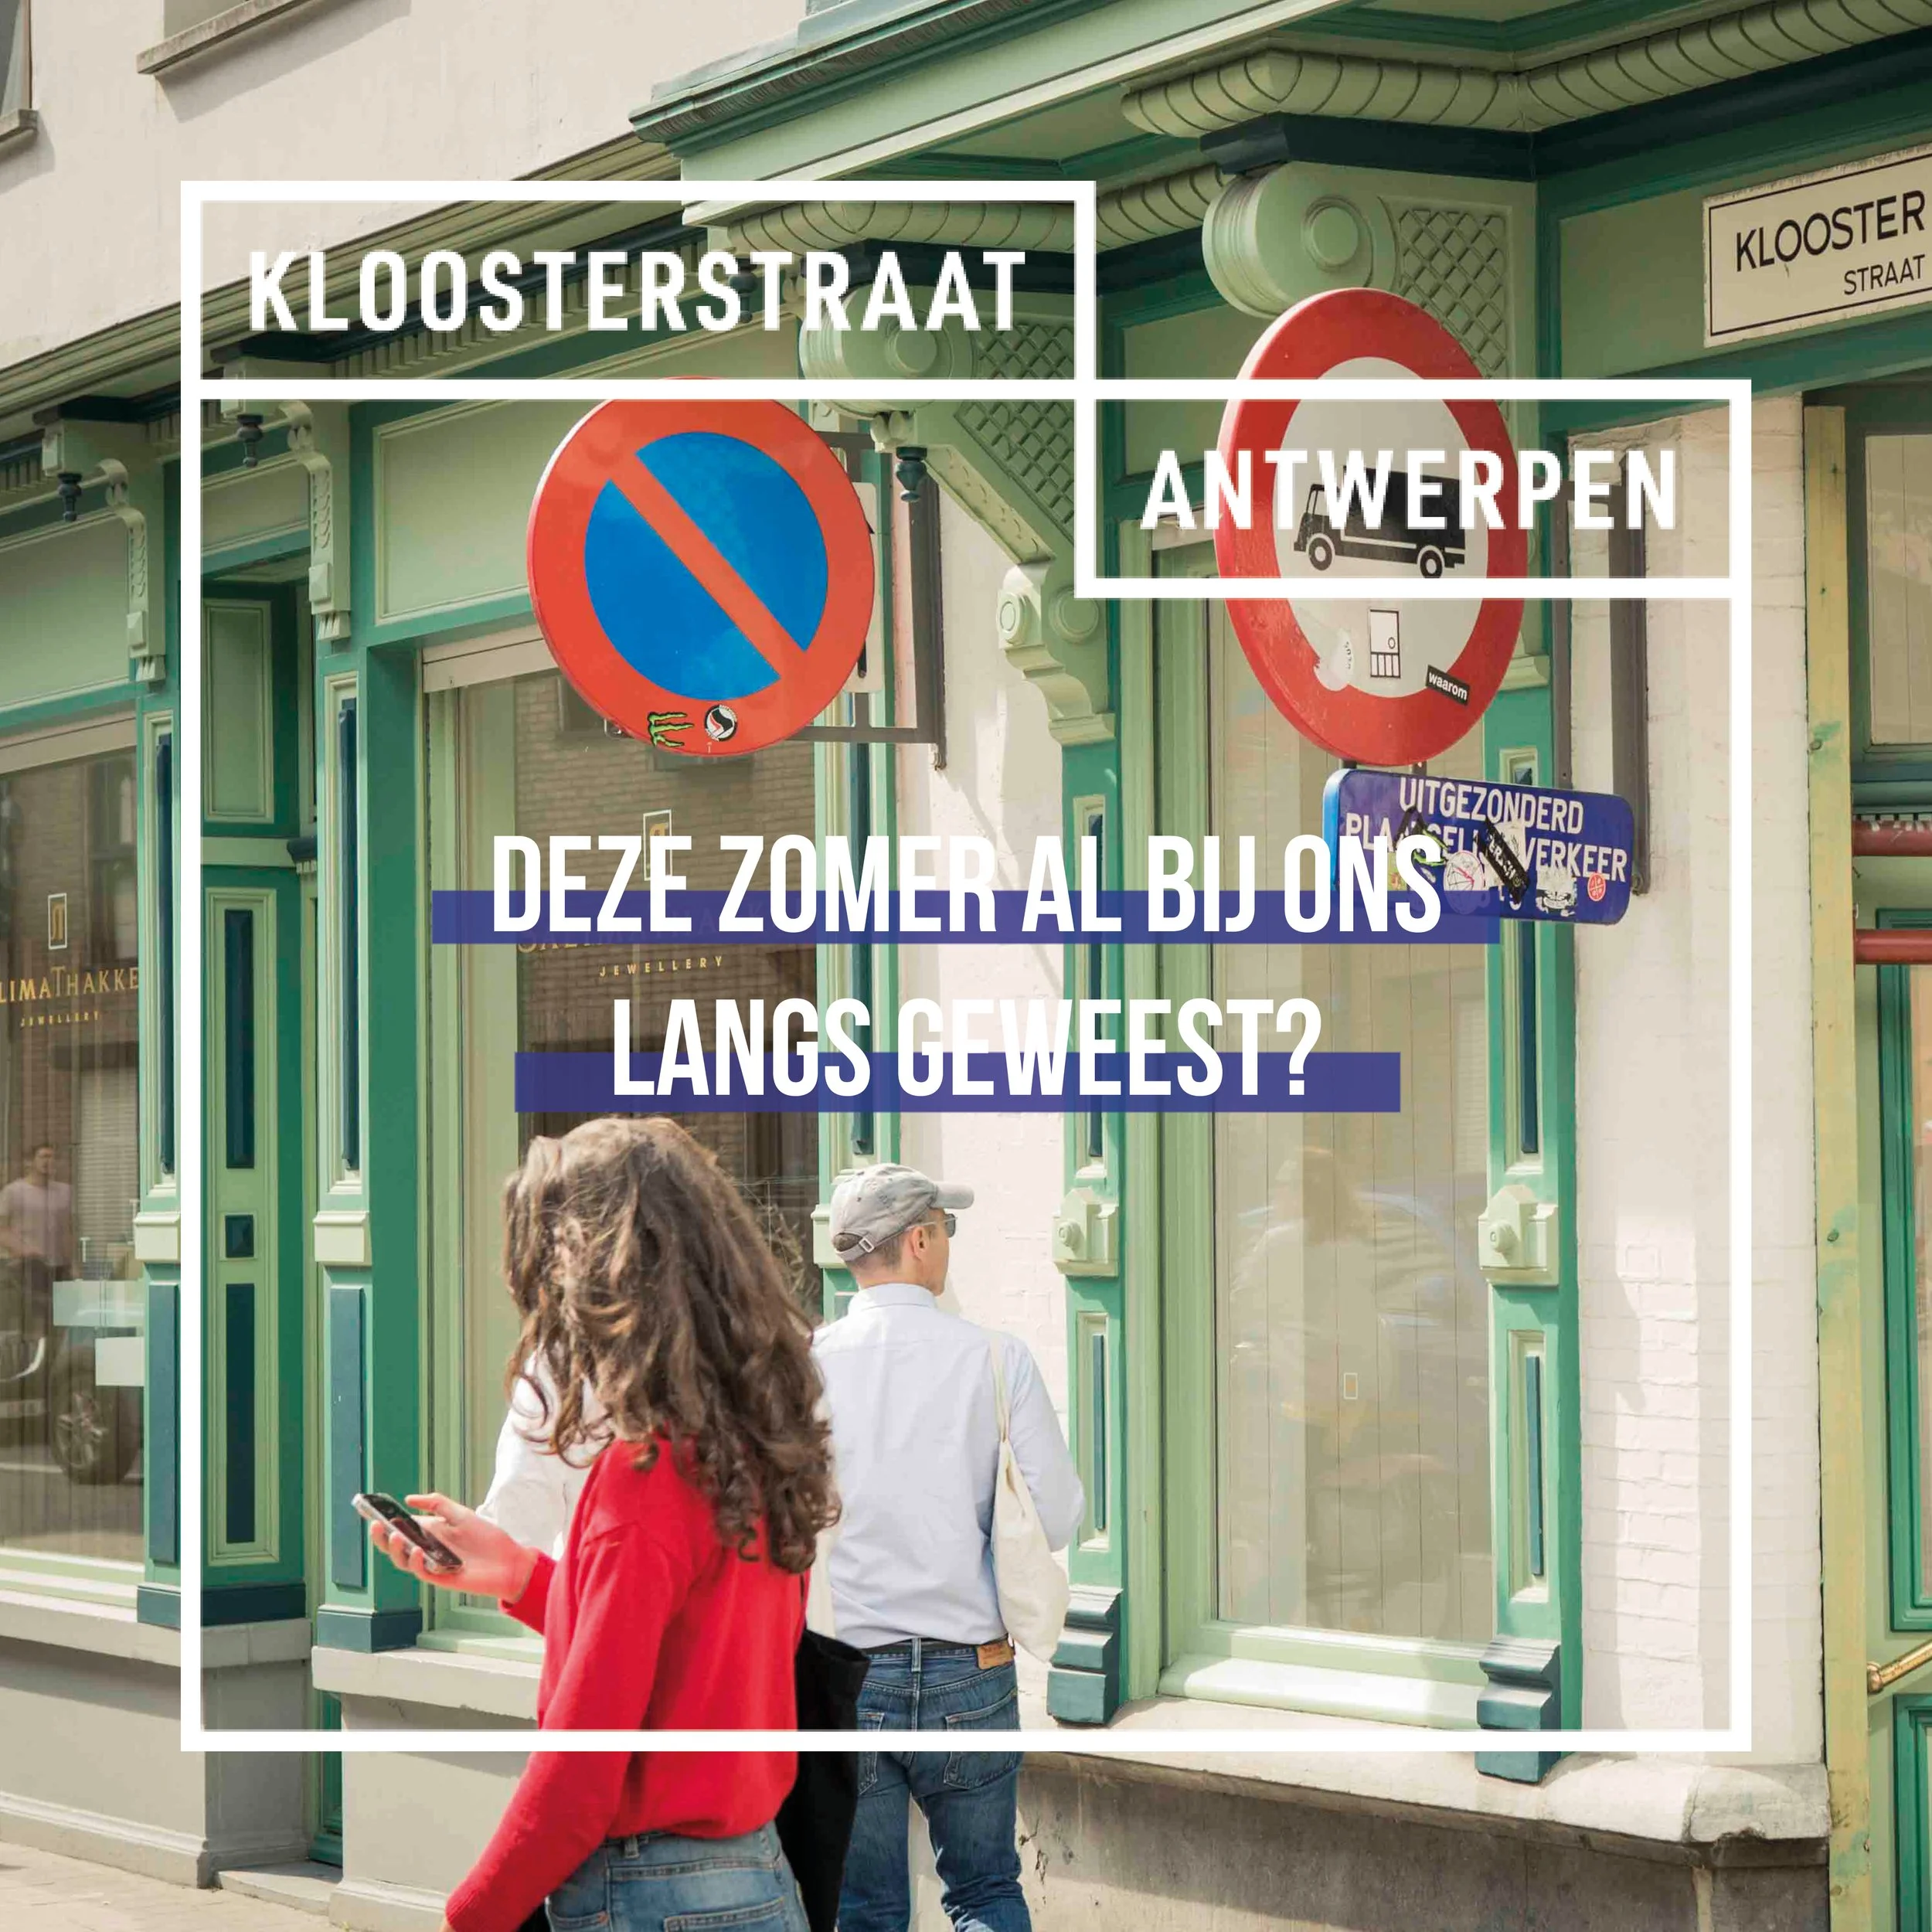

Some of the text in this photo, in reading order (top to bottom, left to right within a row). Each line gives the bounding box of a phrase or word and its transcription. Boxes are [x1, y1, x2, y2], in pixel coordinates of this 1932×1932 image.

[1736, 189, 1926, 272] KLOOSTER
[1843, 253, 1926, 295] STRAAT
[1428, 672, 1468, 701] waarom
[1400, 777, 1584, 835] UITGEZONDERD
[1521, 837, 1628, 883] VERKEER
[599, 955, 723, 978] JEWELLERY
